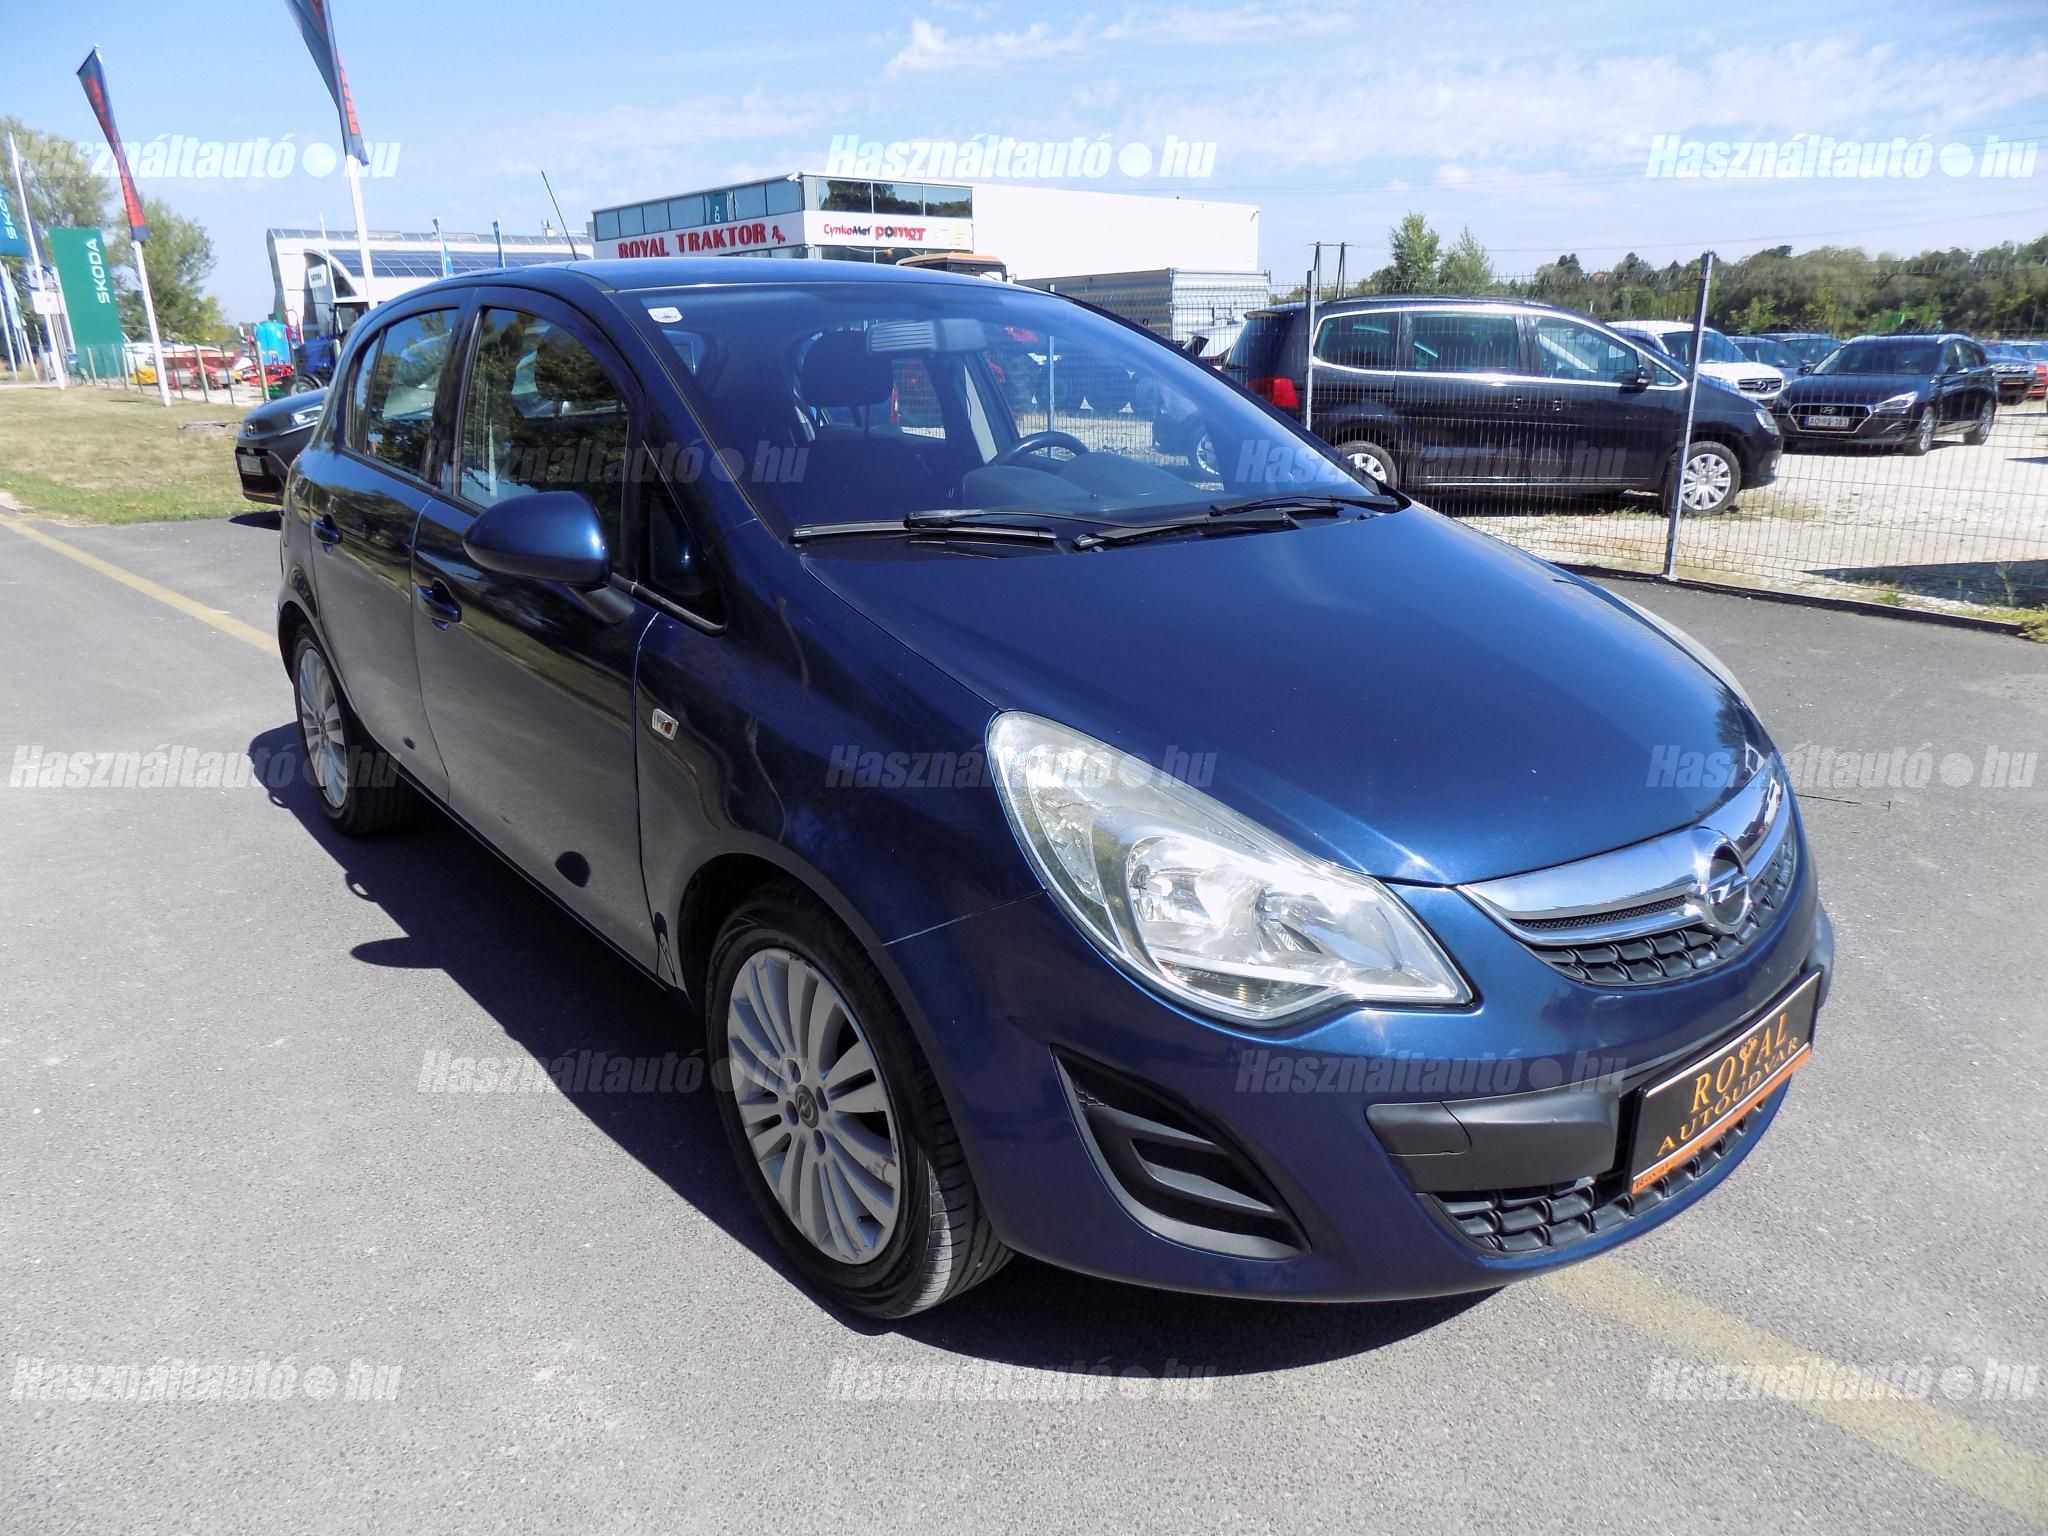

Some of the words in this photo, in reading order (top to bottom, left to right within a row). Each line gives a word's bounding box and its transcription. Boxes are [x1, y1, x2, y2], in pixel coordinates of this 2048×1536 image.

[617, 237, 670, 258] ROYAL
[675, 223, 767, 253] TRAKTOR
[1690, 1012, 1788, 1114] ROYAL
